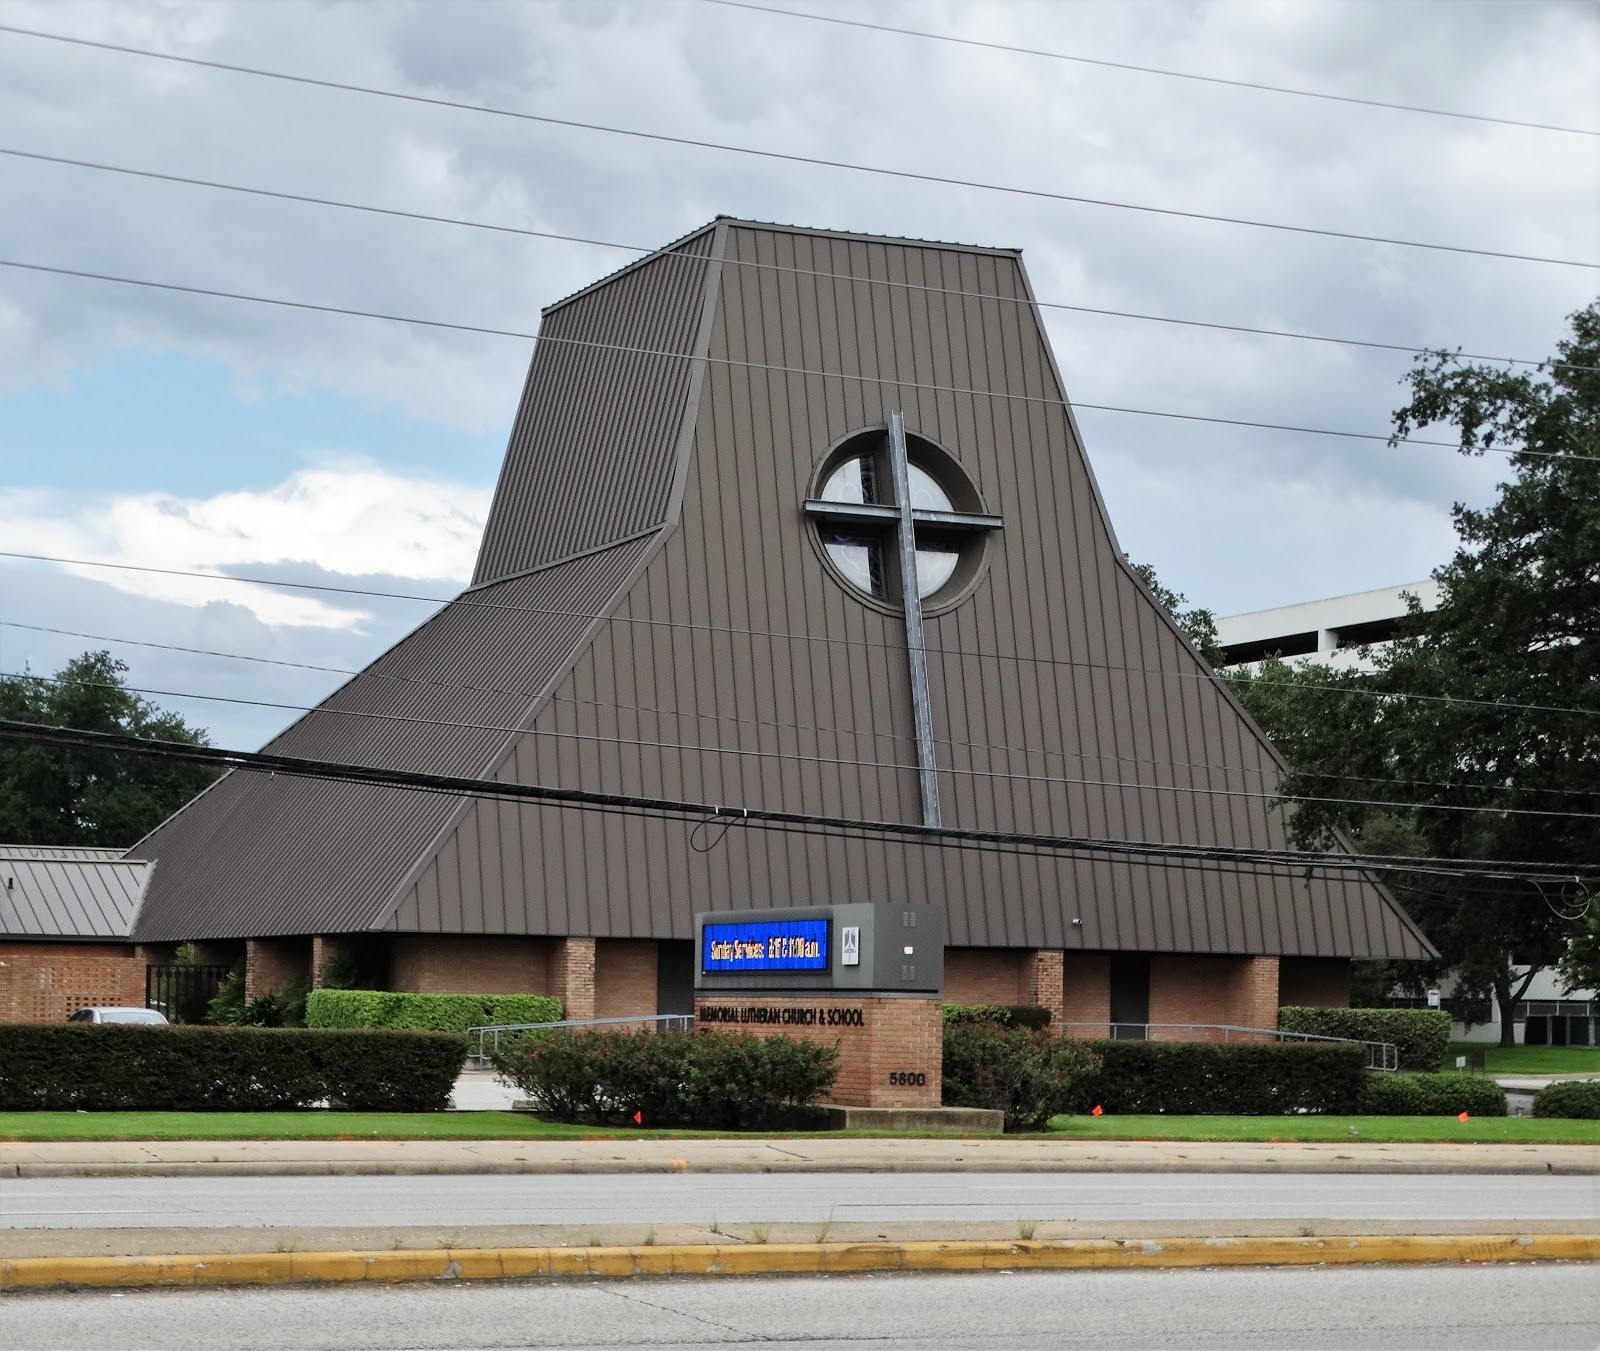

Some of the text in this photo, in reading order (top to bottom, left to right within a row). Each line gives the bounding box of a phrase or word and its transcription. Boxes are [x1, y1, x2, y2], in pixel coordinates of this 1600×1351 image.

[711, 940, 733, 962] Sunday
[700, 1006, 864, 1027] MEMORIAL LUTHERAN CHURCH & SCHOOL
[889, 1072, 925, 1087] 5800
